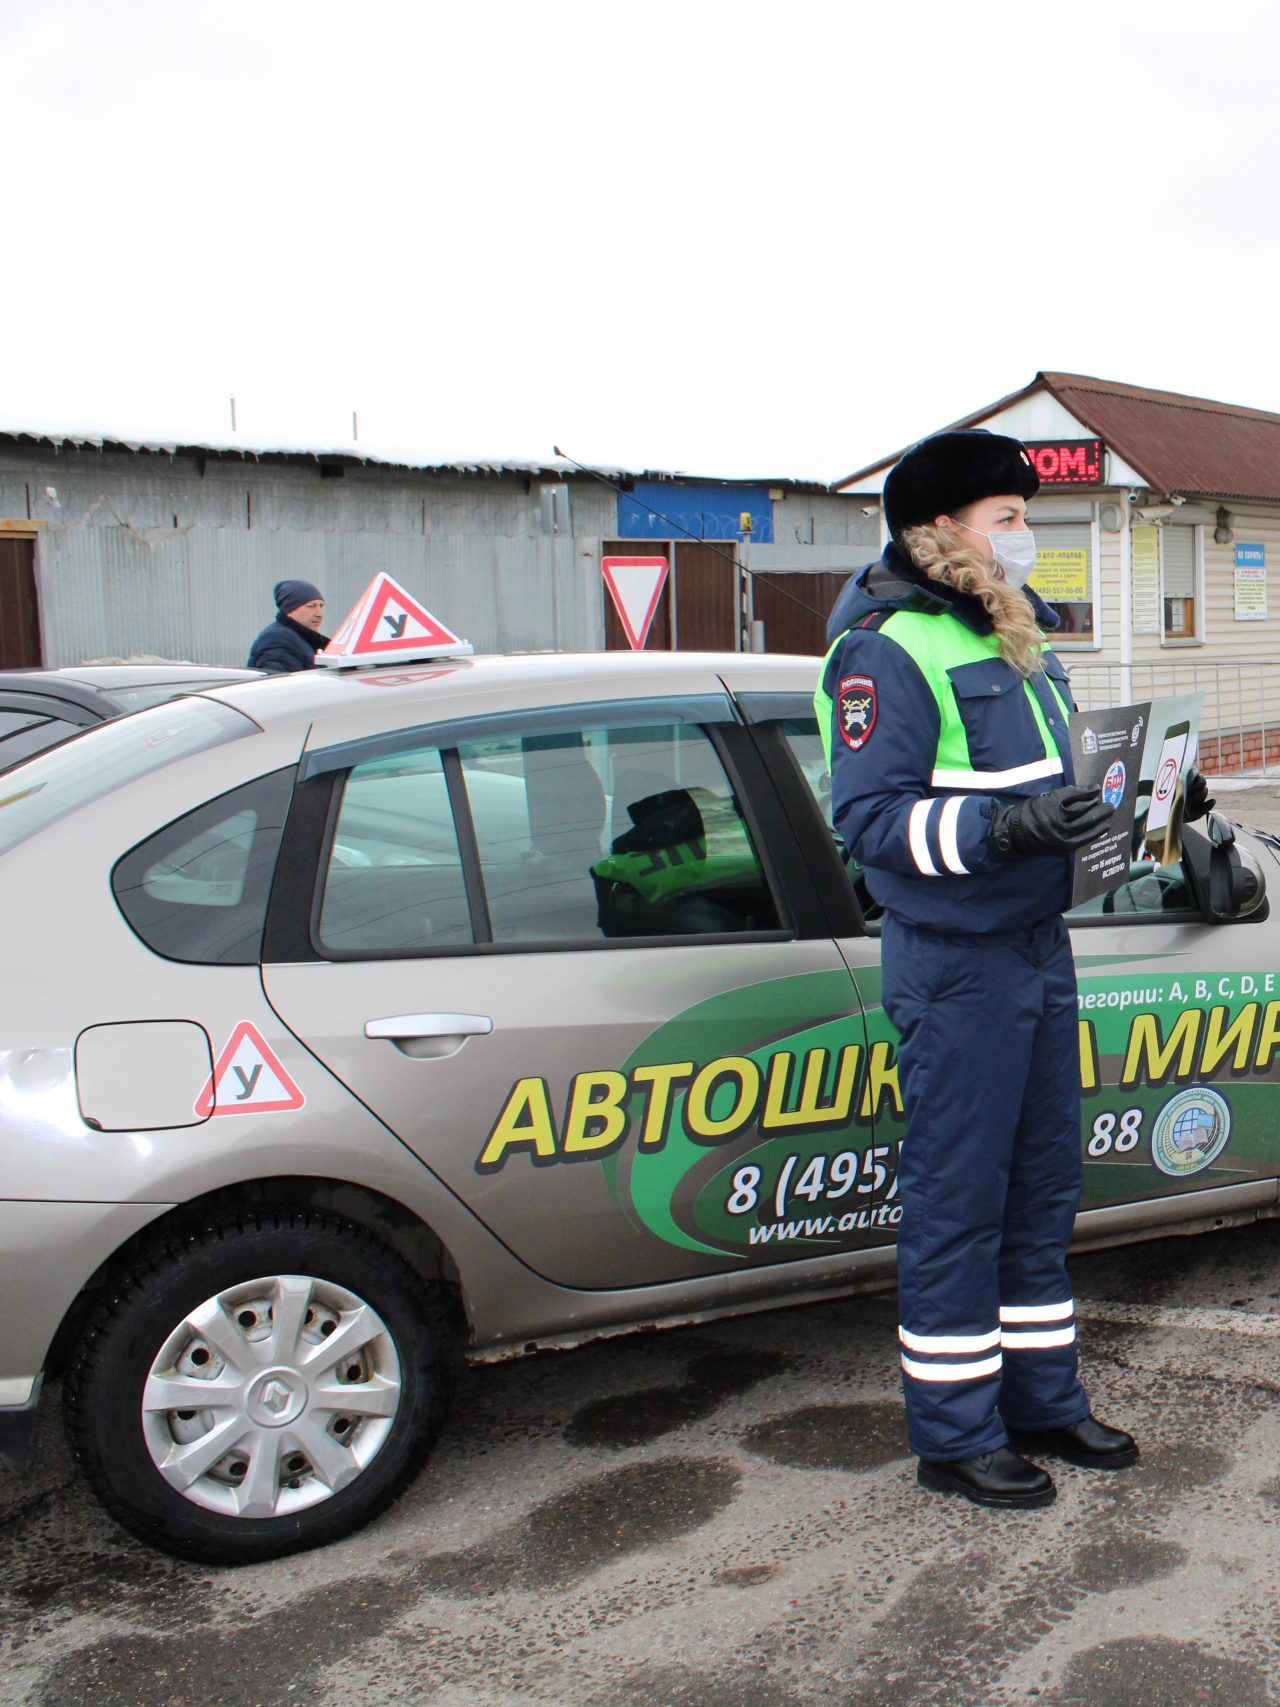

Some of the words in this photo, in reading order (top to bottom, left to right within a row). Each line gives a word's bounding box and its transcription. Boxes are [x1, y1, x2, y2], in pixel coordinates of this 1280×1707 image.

[383, 613, 409, 639] У
[1241, 976, 1258, 997] D,
[232, 1063, 263, 1101] У
[726, 1165, 762, 1215] 8
[749, 1204, 903, 1245] www.auto
